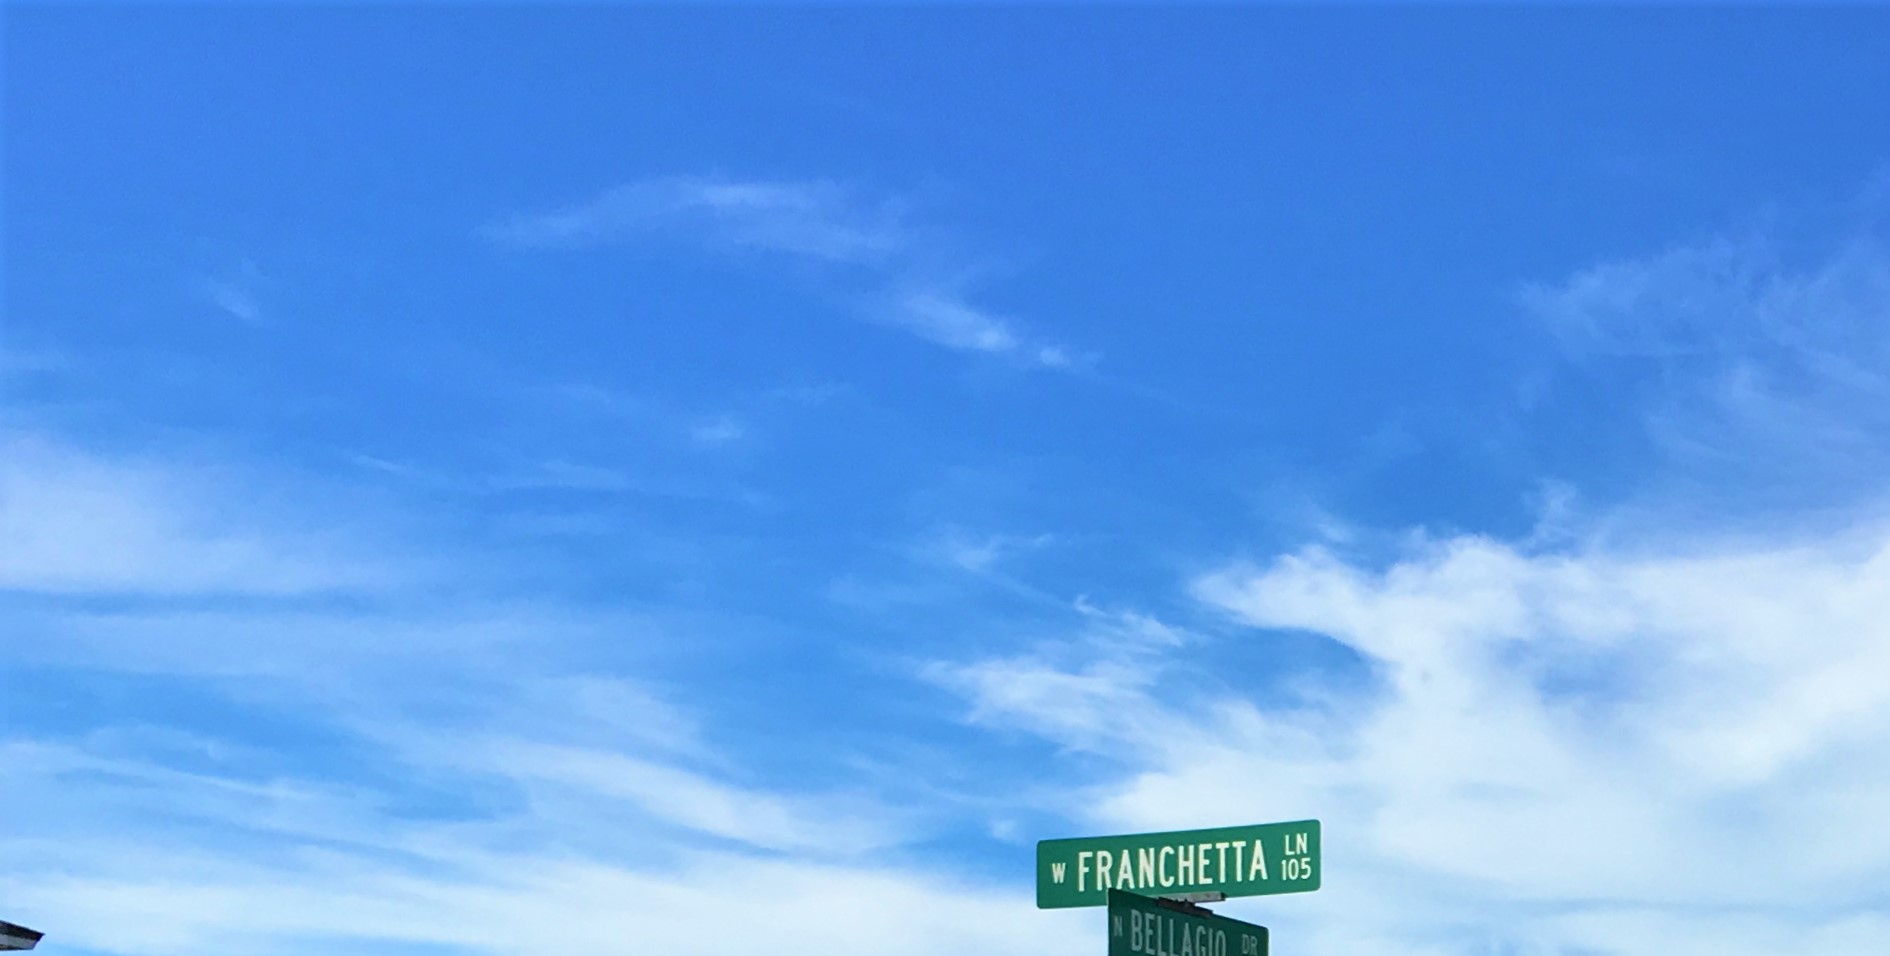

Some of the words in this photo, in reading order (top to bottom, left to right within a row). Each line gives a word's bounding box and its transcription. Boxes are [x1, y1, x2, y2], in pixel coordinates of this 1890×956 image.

[1051, 862, 1067, 884] W
[1077, 839, 1268, 892] FRANCHETTA
[1285, 833, 1308, 856] LN
[1281, 857, 1312, 881] 105
[1113, 915, 1123, 937] N
[1241, 933, 1258, 956] DR
